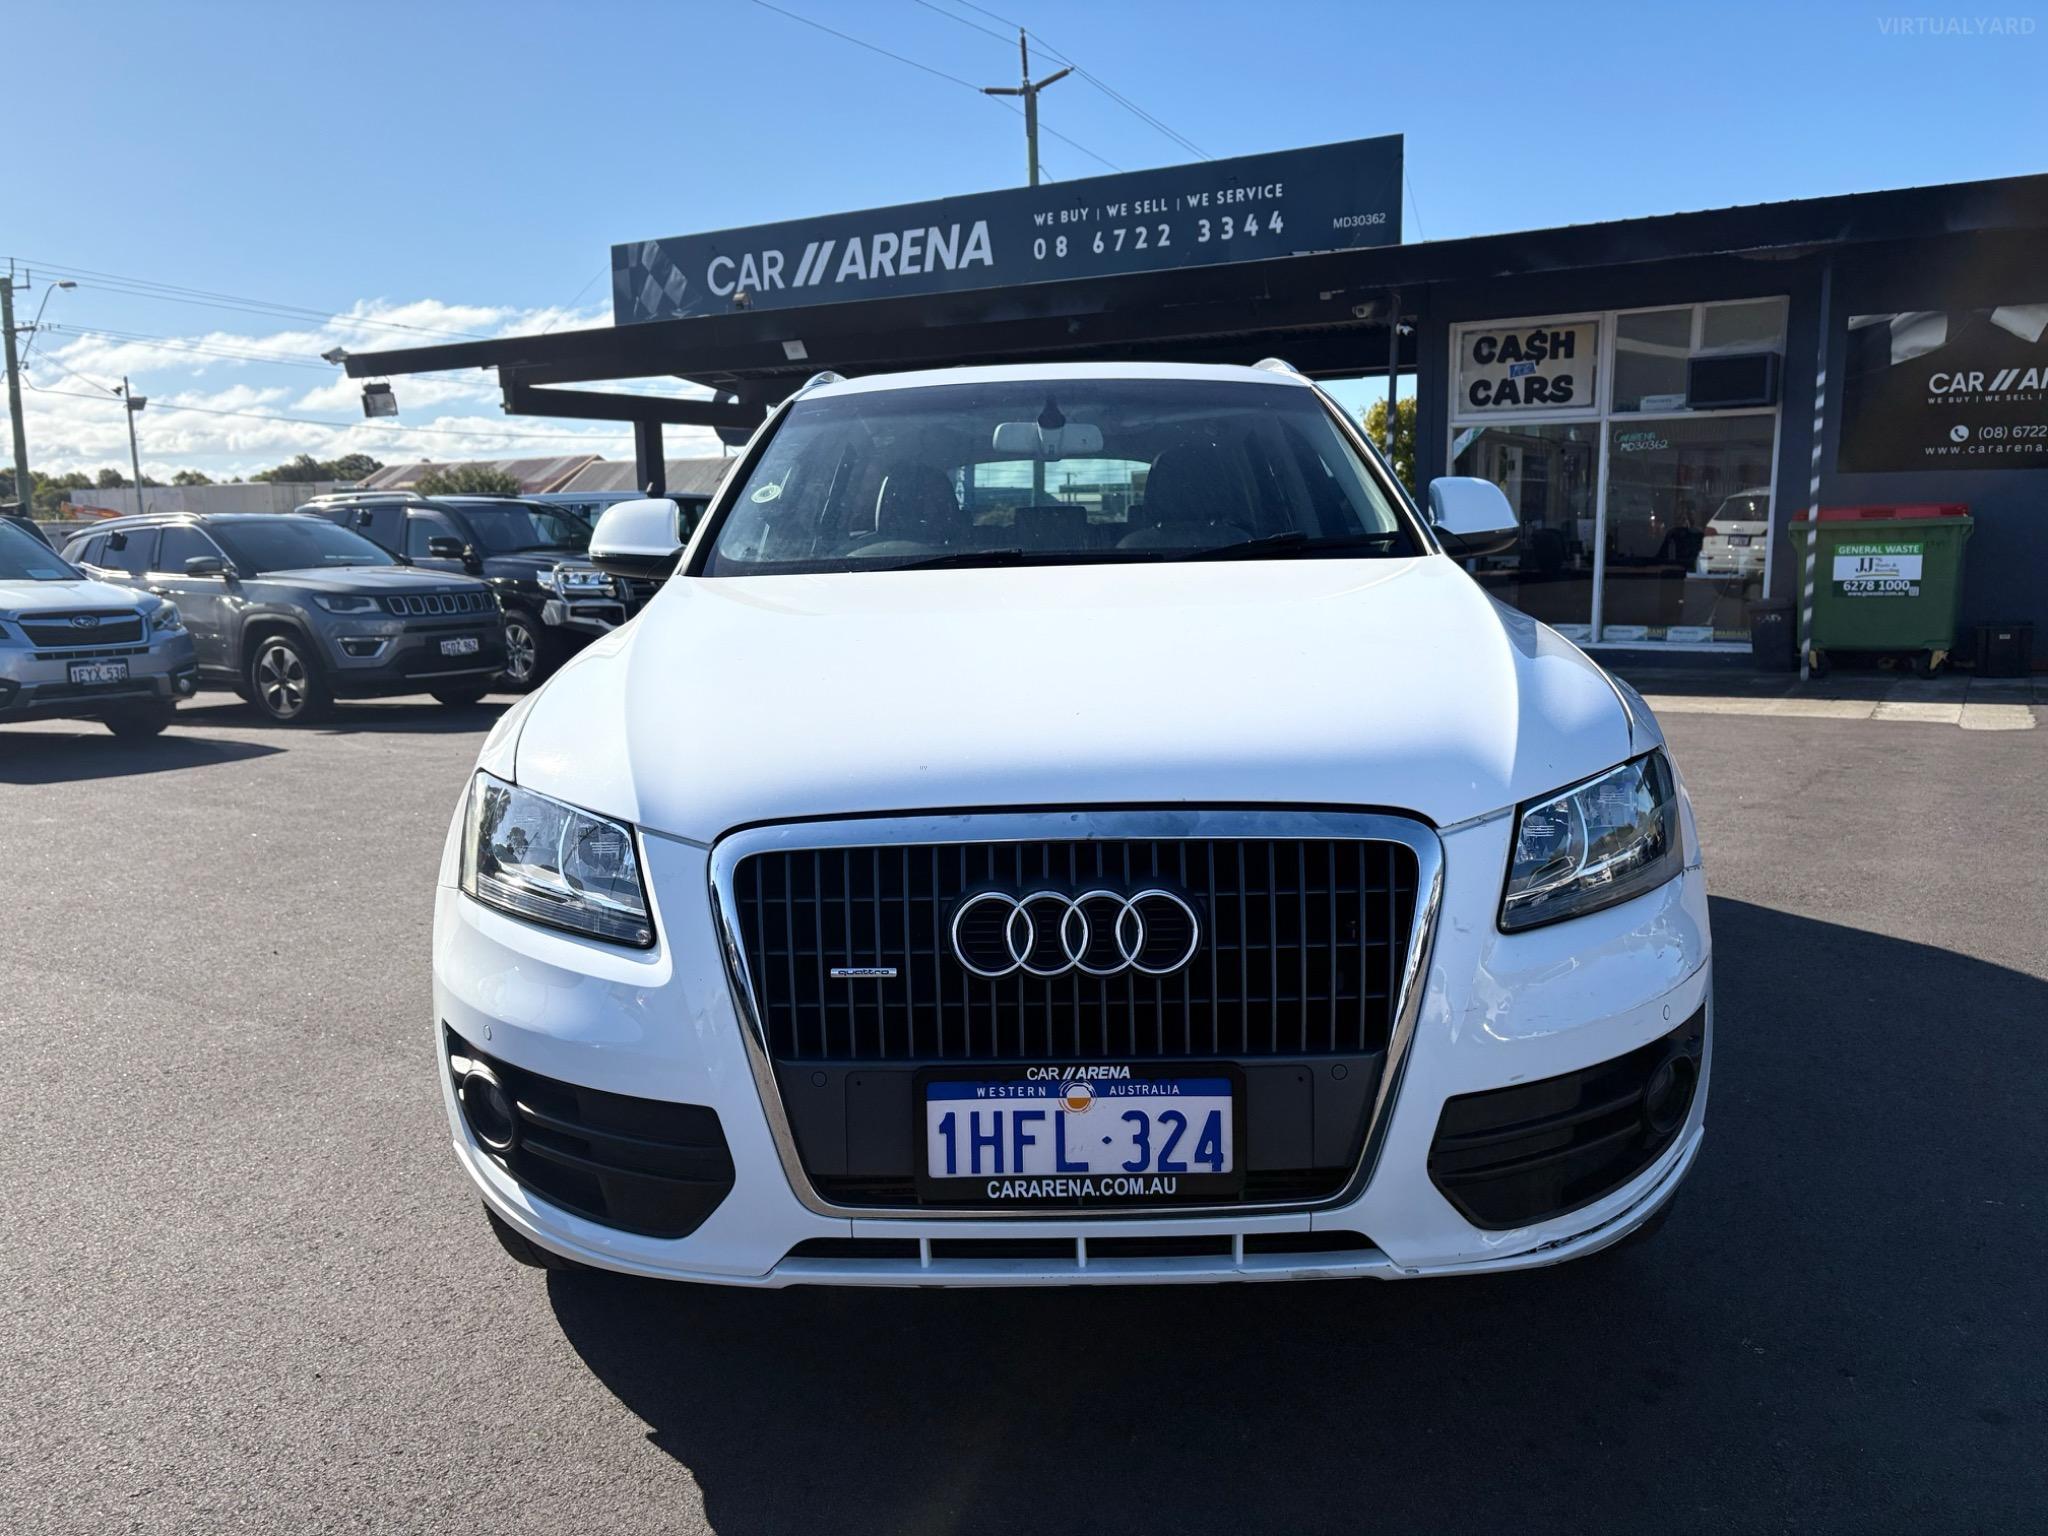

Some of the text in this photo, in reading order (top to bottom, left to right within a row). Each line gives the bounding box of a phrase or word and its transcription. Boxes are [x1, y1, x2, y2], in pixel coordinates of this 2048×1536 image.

[1034, 212, 1053, 226] WE
[1061, 208, 1089, 223] BUY
[1106, 203, 1127, 217] WE
[1134, 198, 1168, 214] SELL
[1187, 193, 1209, 207] WE
[1216, 183, 1283, 204] SERVICE
[1333, 212, 1386, 229] MD30362
[1033, 210, 1284, 260] 08 6722 3344
[707, 250, 785, 296] CAR
[835, 220, 994, 282] ARENA
[1468, 374, 1574, 407] CARS
[1928, 371, 1985, 394] CAR
[1948, 396, 1970, 404] BUY
[2006, 393, 2032, 401] SELL
[1978, 425, 2048, 440] (08) 6722
[1838, 544, 1919, 555] GENERAL WASTE
[1843, 580, 1910, 591] 6278 1000
[1026, 1067, 1059, 1080] CAR
[1076, 1066, 1131, 1080] ARENA
[976, 1084, 1180, 1098] WESTERN AUSTRALIA
[986, 1177, 1177, 1199] CARARENA.COM.AU
